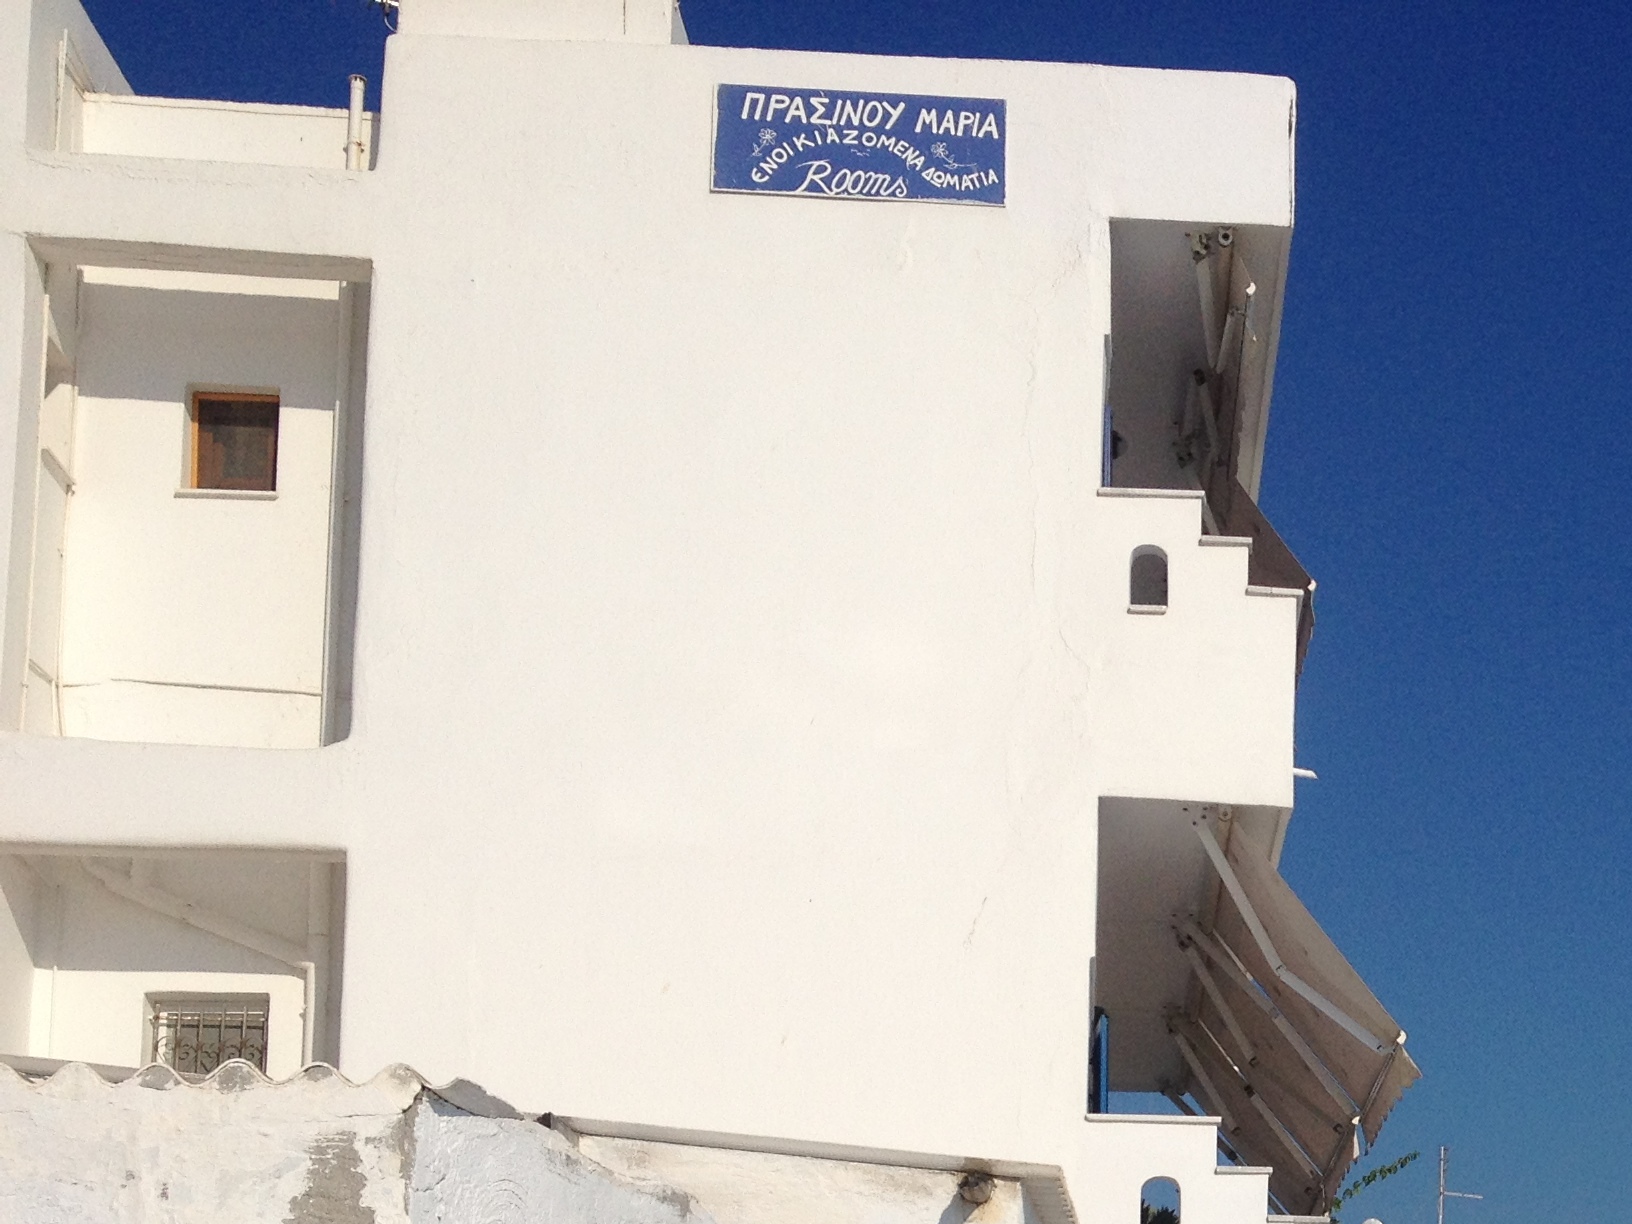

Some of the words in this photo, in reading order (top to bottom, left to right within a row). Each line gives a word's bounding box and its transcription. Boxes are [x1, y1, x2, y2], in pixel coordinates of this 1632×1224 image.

[741, 92, 905, 130] ΠΡΑΣΙΝΟΥ
[915, 108, 999, 139] ΜΑΡΙΑ
[796, 159, 908, 197] Rooms
[921, 168, 999, 192] ΔΩΜΑΤΙΑ
